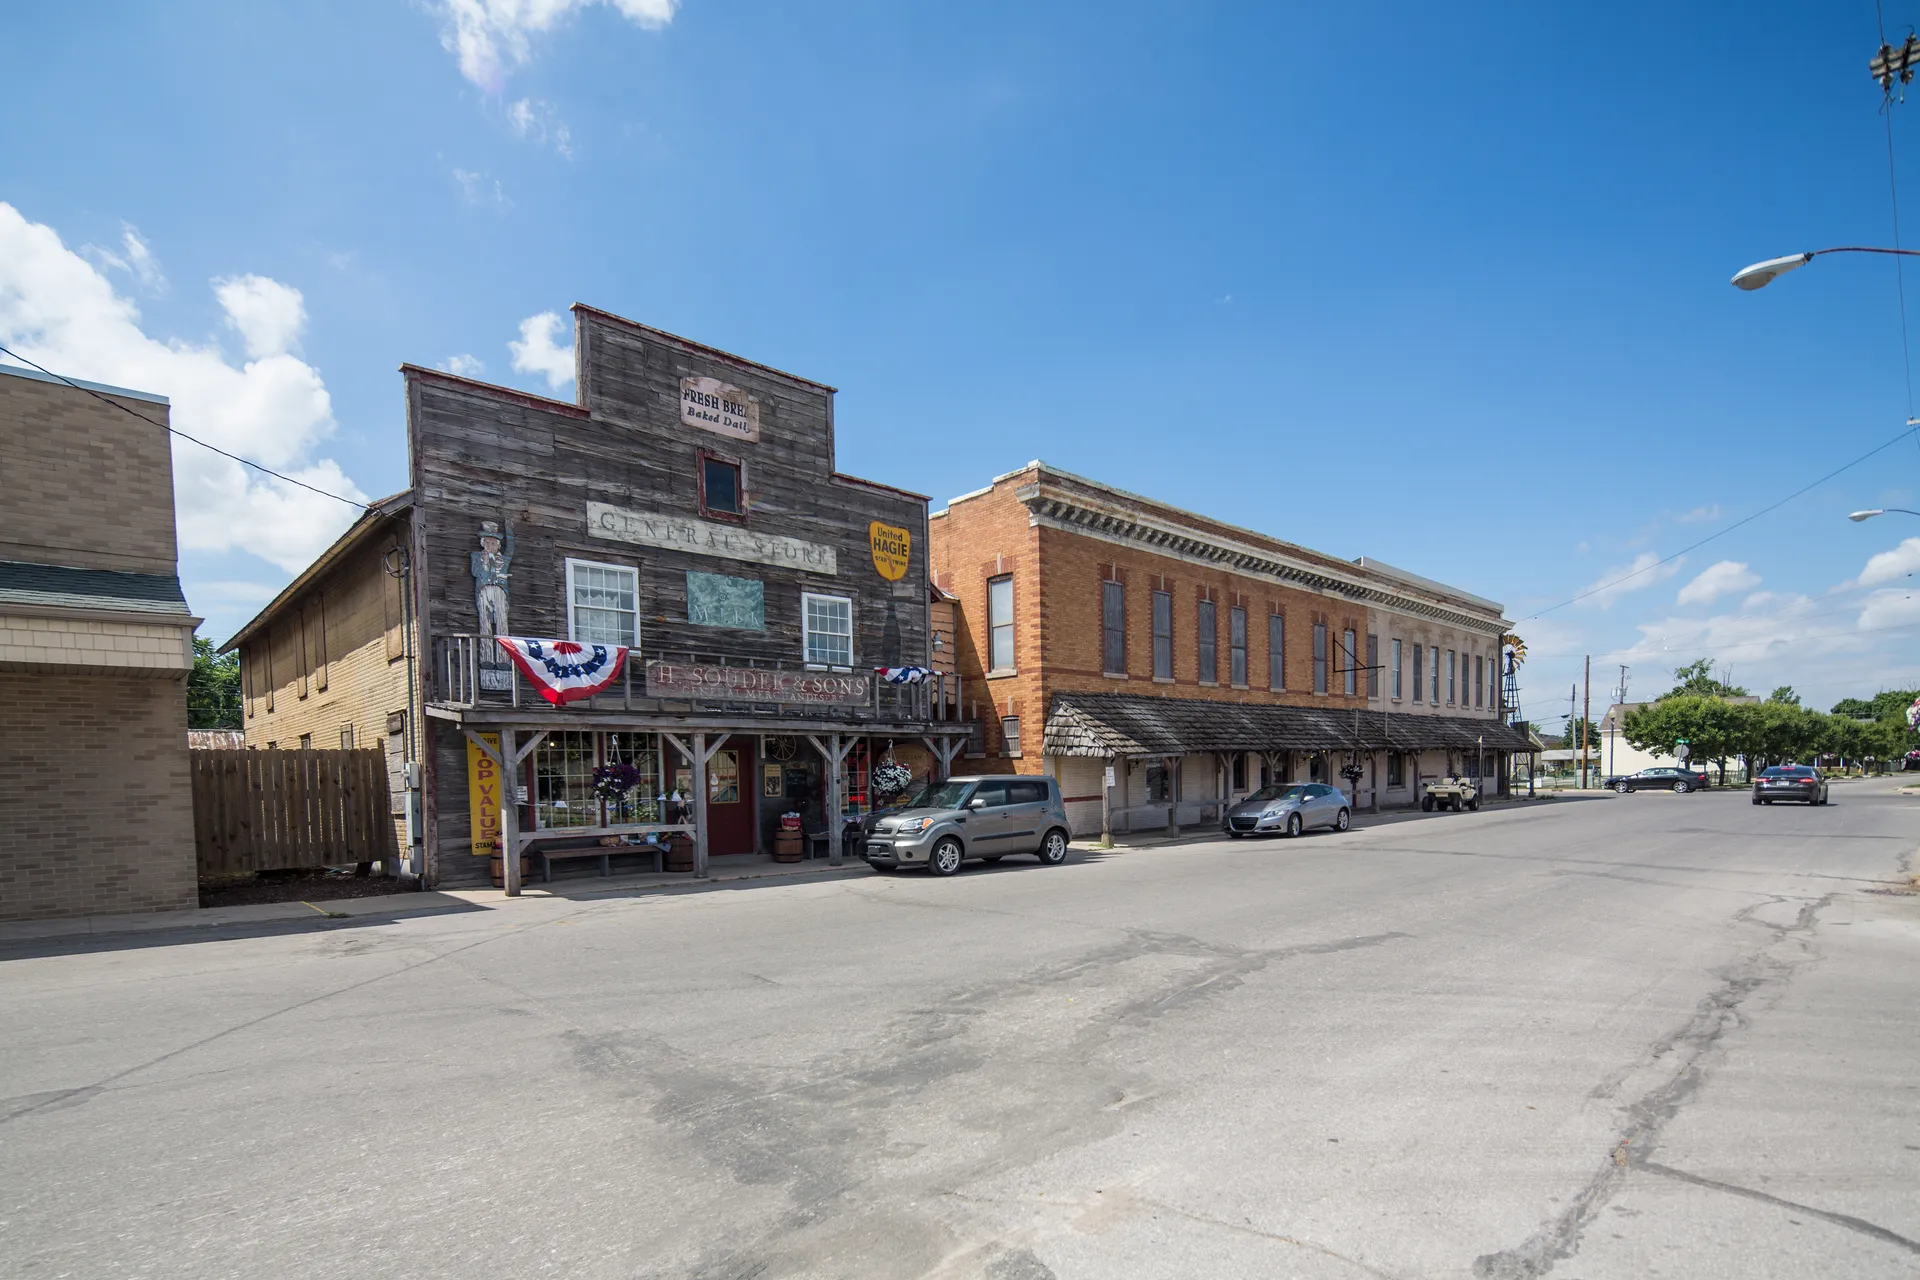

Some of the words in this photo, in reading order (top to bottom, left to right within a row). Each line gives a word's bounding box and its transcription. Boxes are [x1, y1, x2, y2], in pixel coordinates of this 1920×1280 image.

[682, 388, 720, 410] FRESH
[687, 406, 720, 424] Baked
[600, 512, 742, 550] GENERAL
[877, 526, 903, 542] United
[873, 537, 907, 557] HAGIE
[792, 674, 807, 692] &
[812, 677, 864, 696] SONS
[479, 784, 496, 839] VALUE
